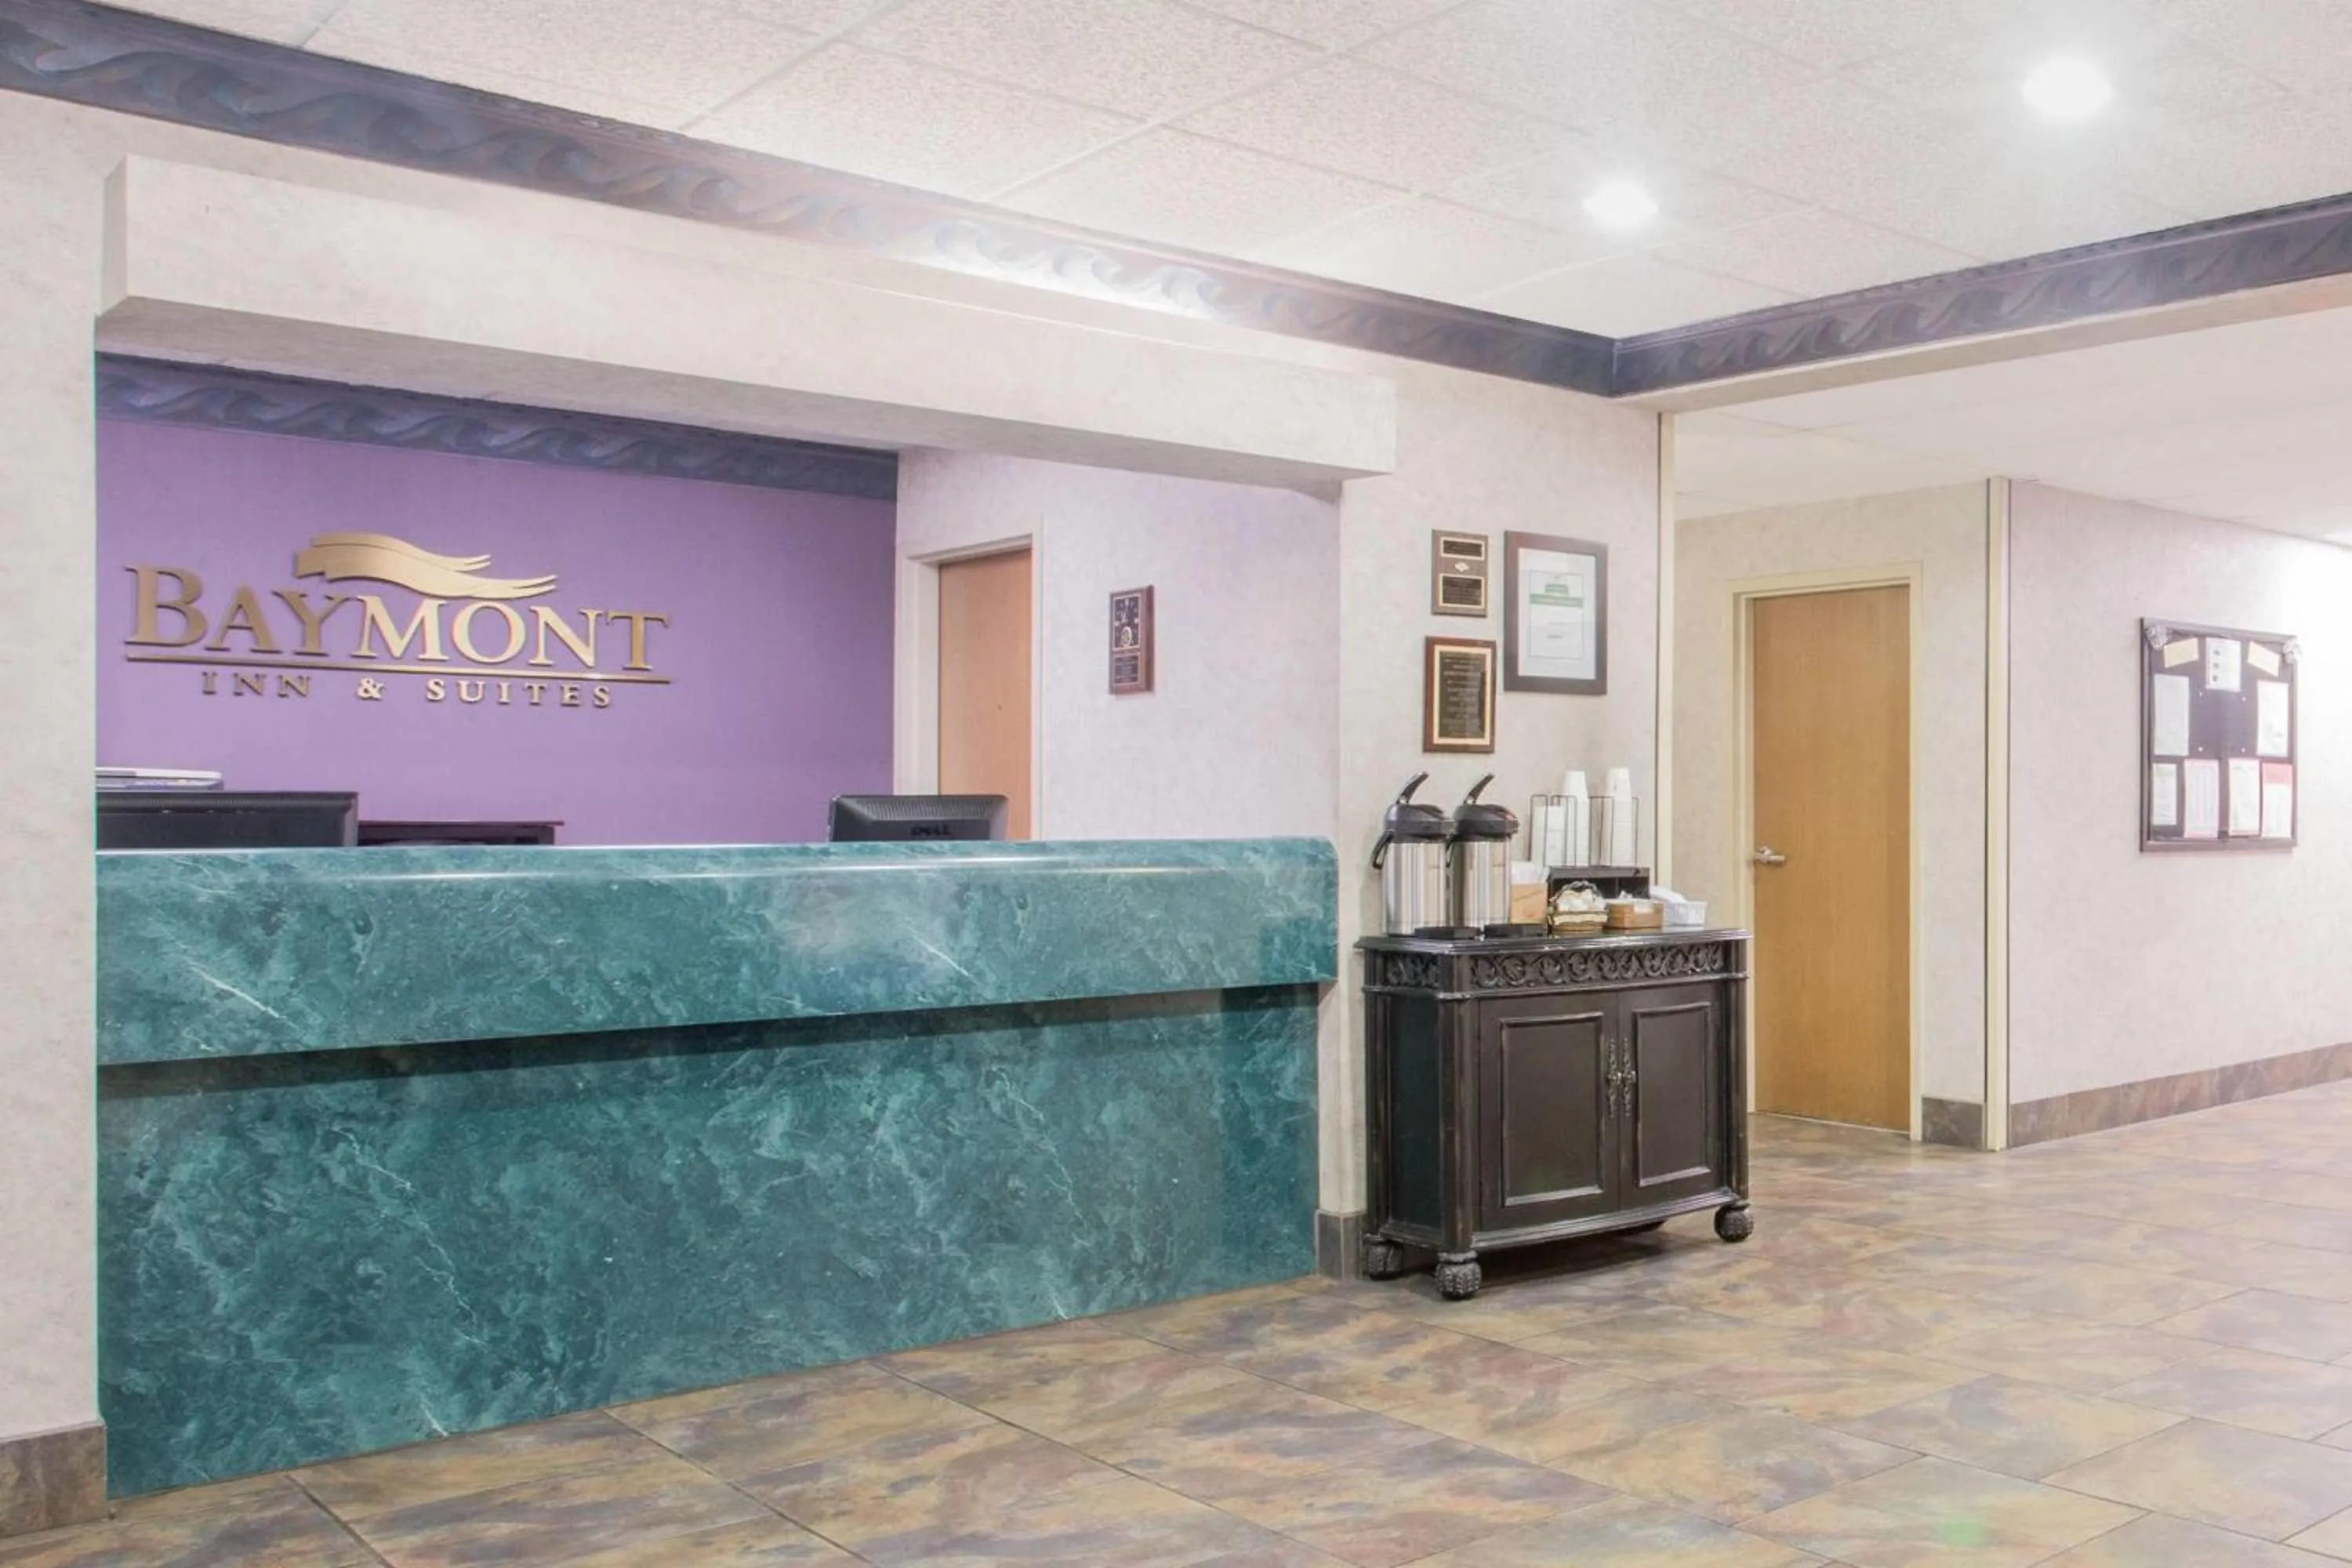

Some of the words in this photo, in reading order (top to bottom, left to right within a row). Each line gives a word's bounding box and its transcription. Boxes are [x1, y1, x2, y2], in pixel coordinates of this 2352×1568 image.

[125, 564, 669, 671] BAYMONT
[201, 671, 312, 696] INN
[358, 677, 385, 700] &
[426, 678, 613, 707] SUITES
